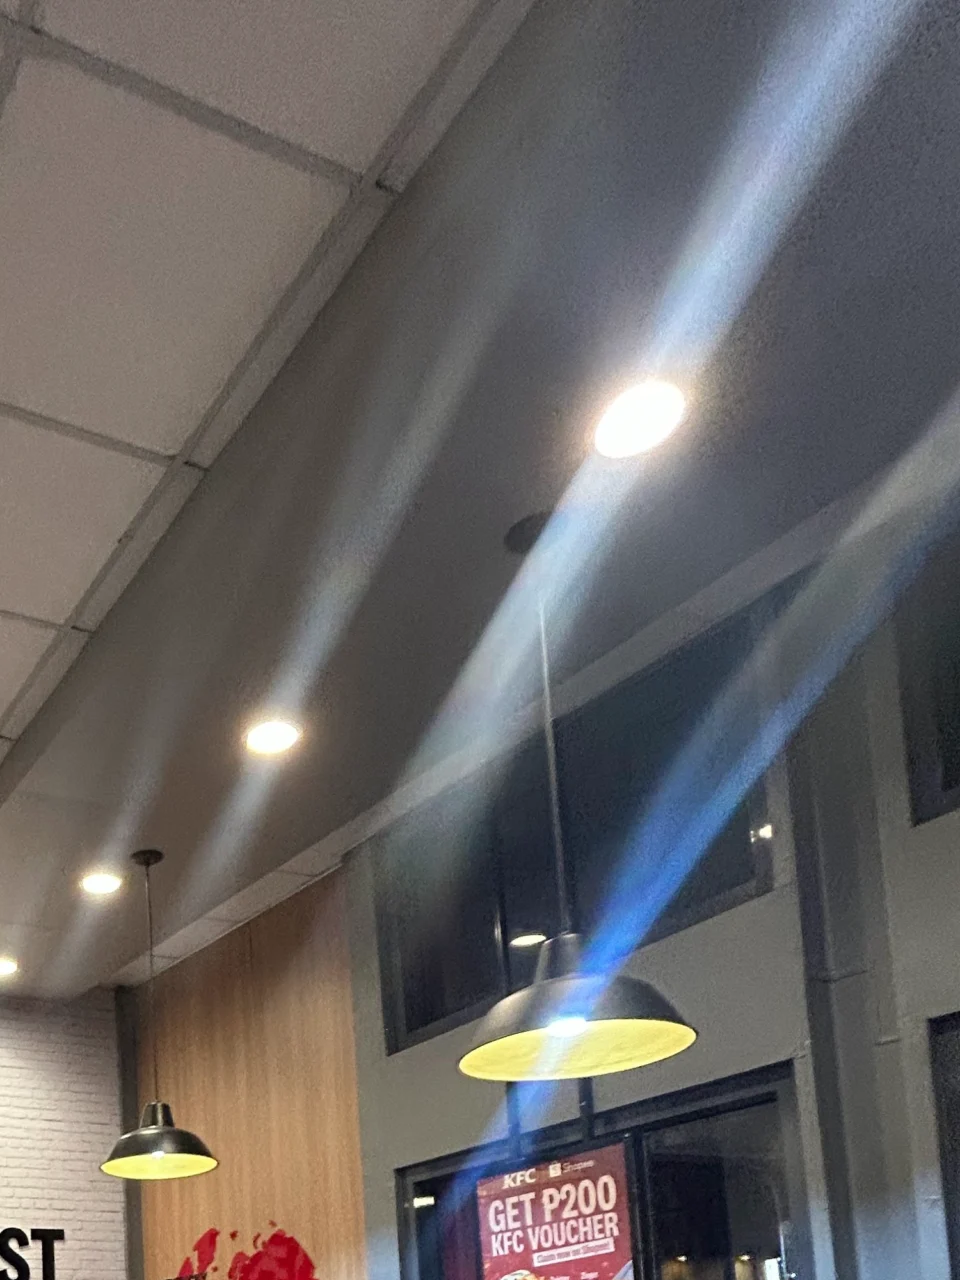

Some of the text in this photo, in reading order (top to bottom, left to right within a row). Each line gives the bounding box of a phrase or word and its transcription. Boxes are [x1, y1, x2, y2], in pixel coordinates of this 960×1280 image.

[502, 1168, 537, 1189] KFC
[489, 1191, 536, 1232] GET
[491, 1230, 525, 1257] KFC
[527, 1212, 620, 1250] VOUCHER
